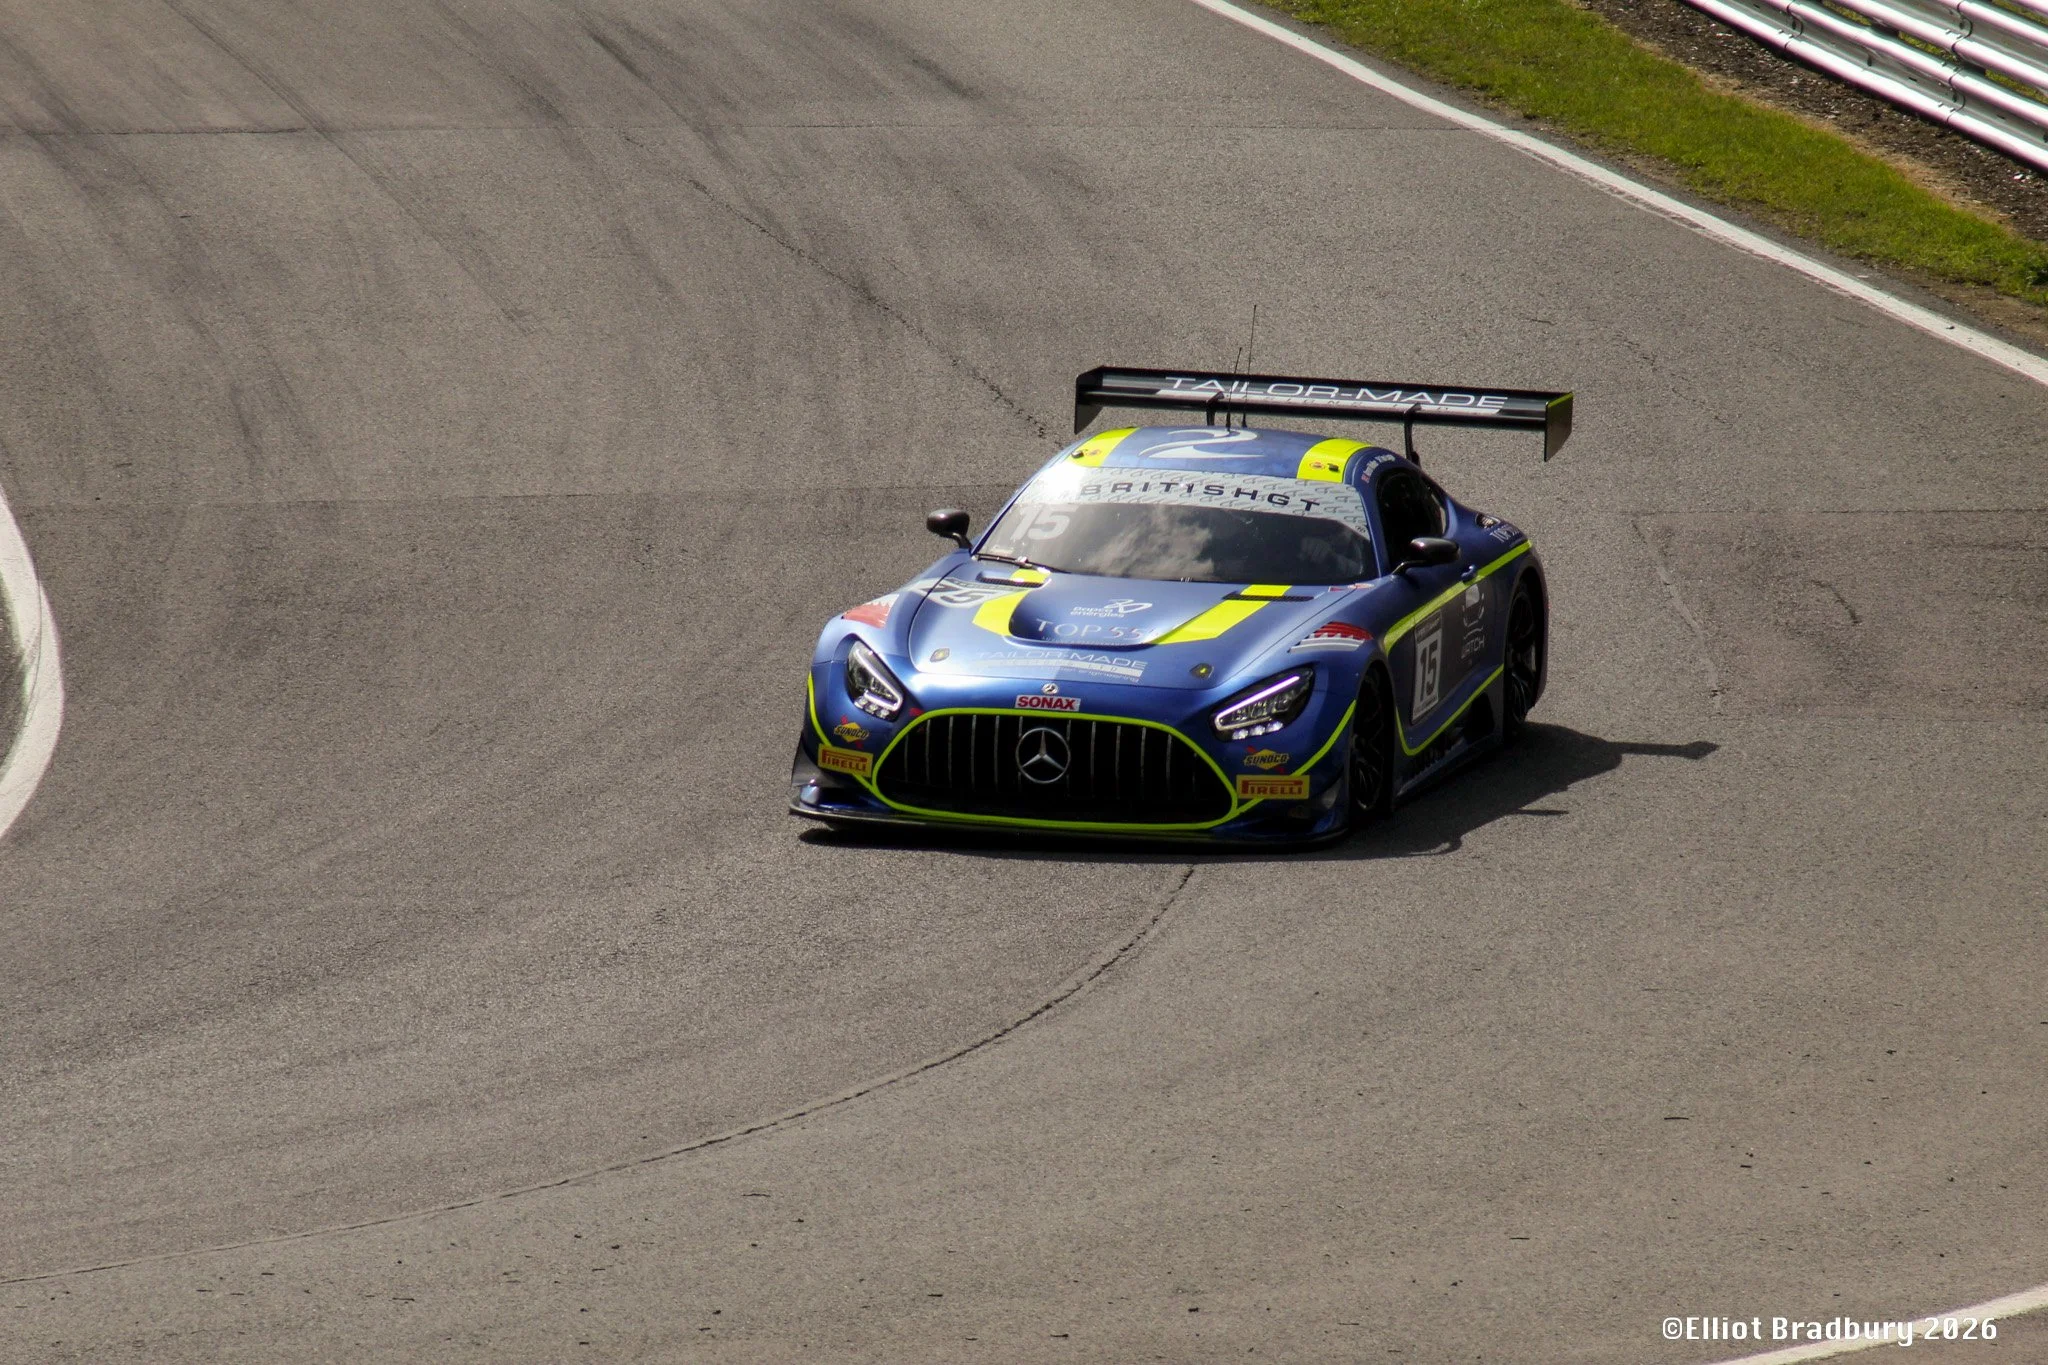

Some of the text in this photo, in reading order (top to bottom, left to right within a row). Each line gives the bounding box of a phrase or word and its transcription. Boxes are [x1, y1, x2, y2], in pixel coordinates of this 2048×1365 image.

[1165, 376, 1508, 409] TAILOR-MADE
[1009, 504, 1079, 541] 15
[1037, 618, 1101, 638] TOP
[977, 650, 1148, 669] TAILOR-MADE
[1420, 639, 1439, 702] 15
[1018, 695, 1077, 711] SONAX
[835, 725, 869, 740] SUNOCO
[822, 750, 868, 772] PIRELLI
[1246, 753, 1289, 764] SUNOCO
[1241, 779, 1303, 795] PIRELLI
